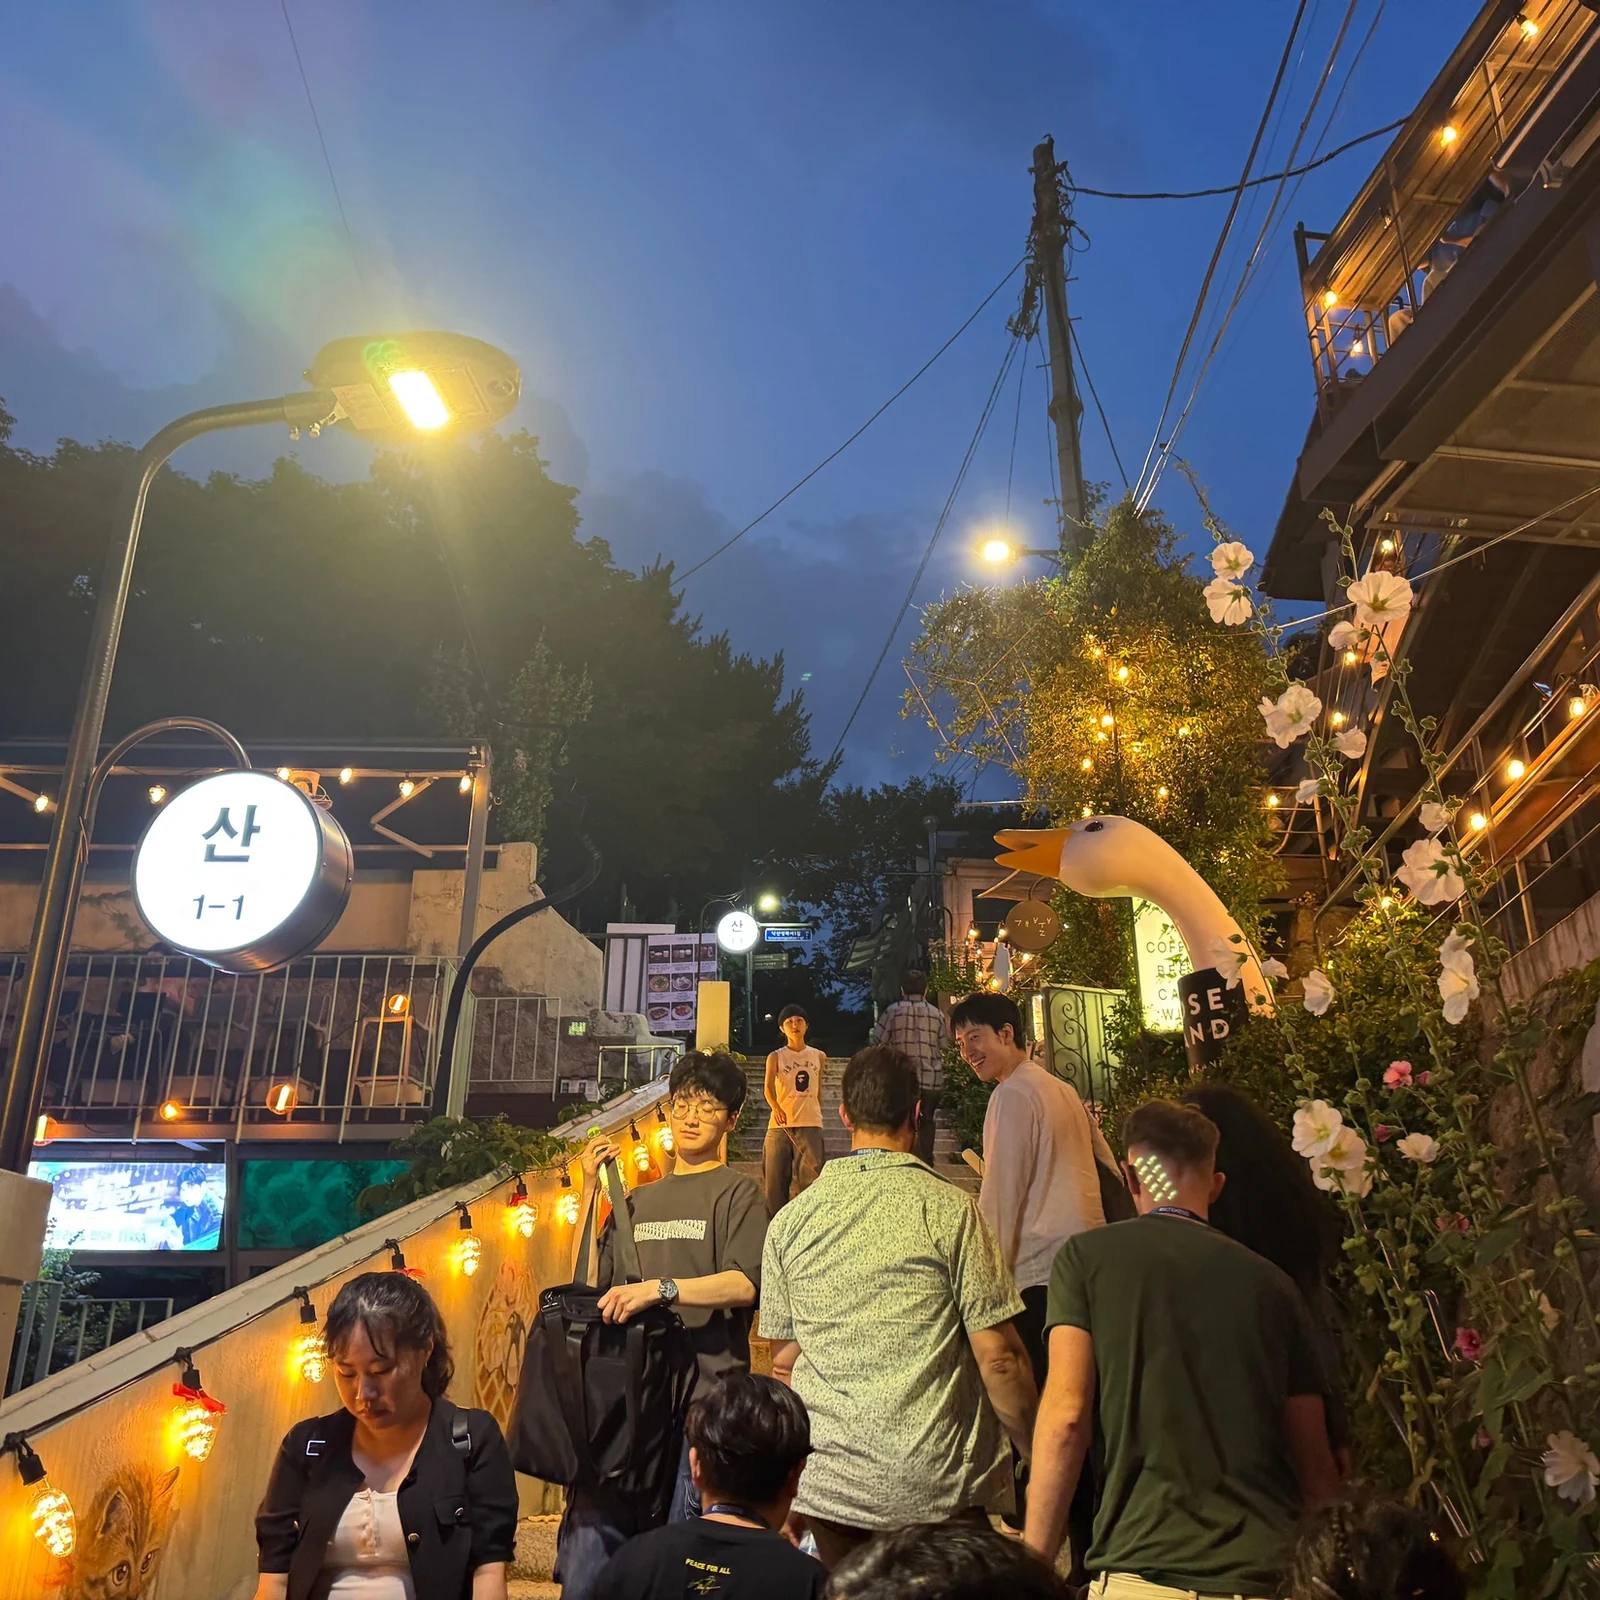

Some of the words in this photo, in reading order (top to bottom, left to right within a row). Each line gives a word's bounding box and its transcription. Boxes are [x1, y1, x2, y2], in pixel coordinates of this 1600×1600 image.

[202, 804, 261, 862] 산
[193, 894, 244, 920] 1-1
[731, 919, 743, 932] 산
[1146, 941, 1184, 954] COFF
[1157, 963, 1187, 977] BEE
[1158, 988, 1179, 1001] CA
[1182, 987, 1224, 1019] SE
[685, 1558, 706, 1570] PEACE
[706, 1564, 718, 1573] FOR
[719, 1567, 731, 1575] ALL
